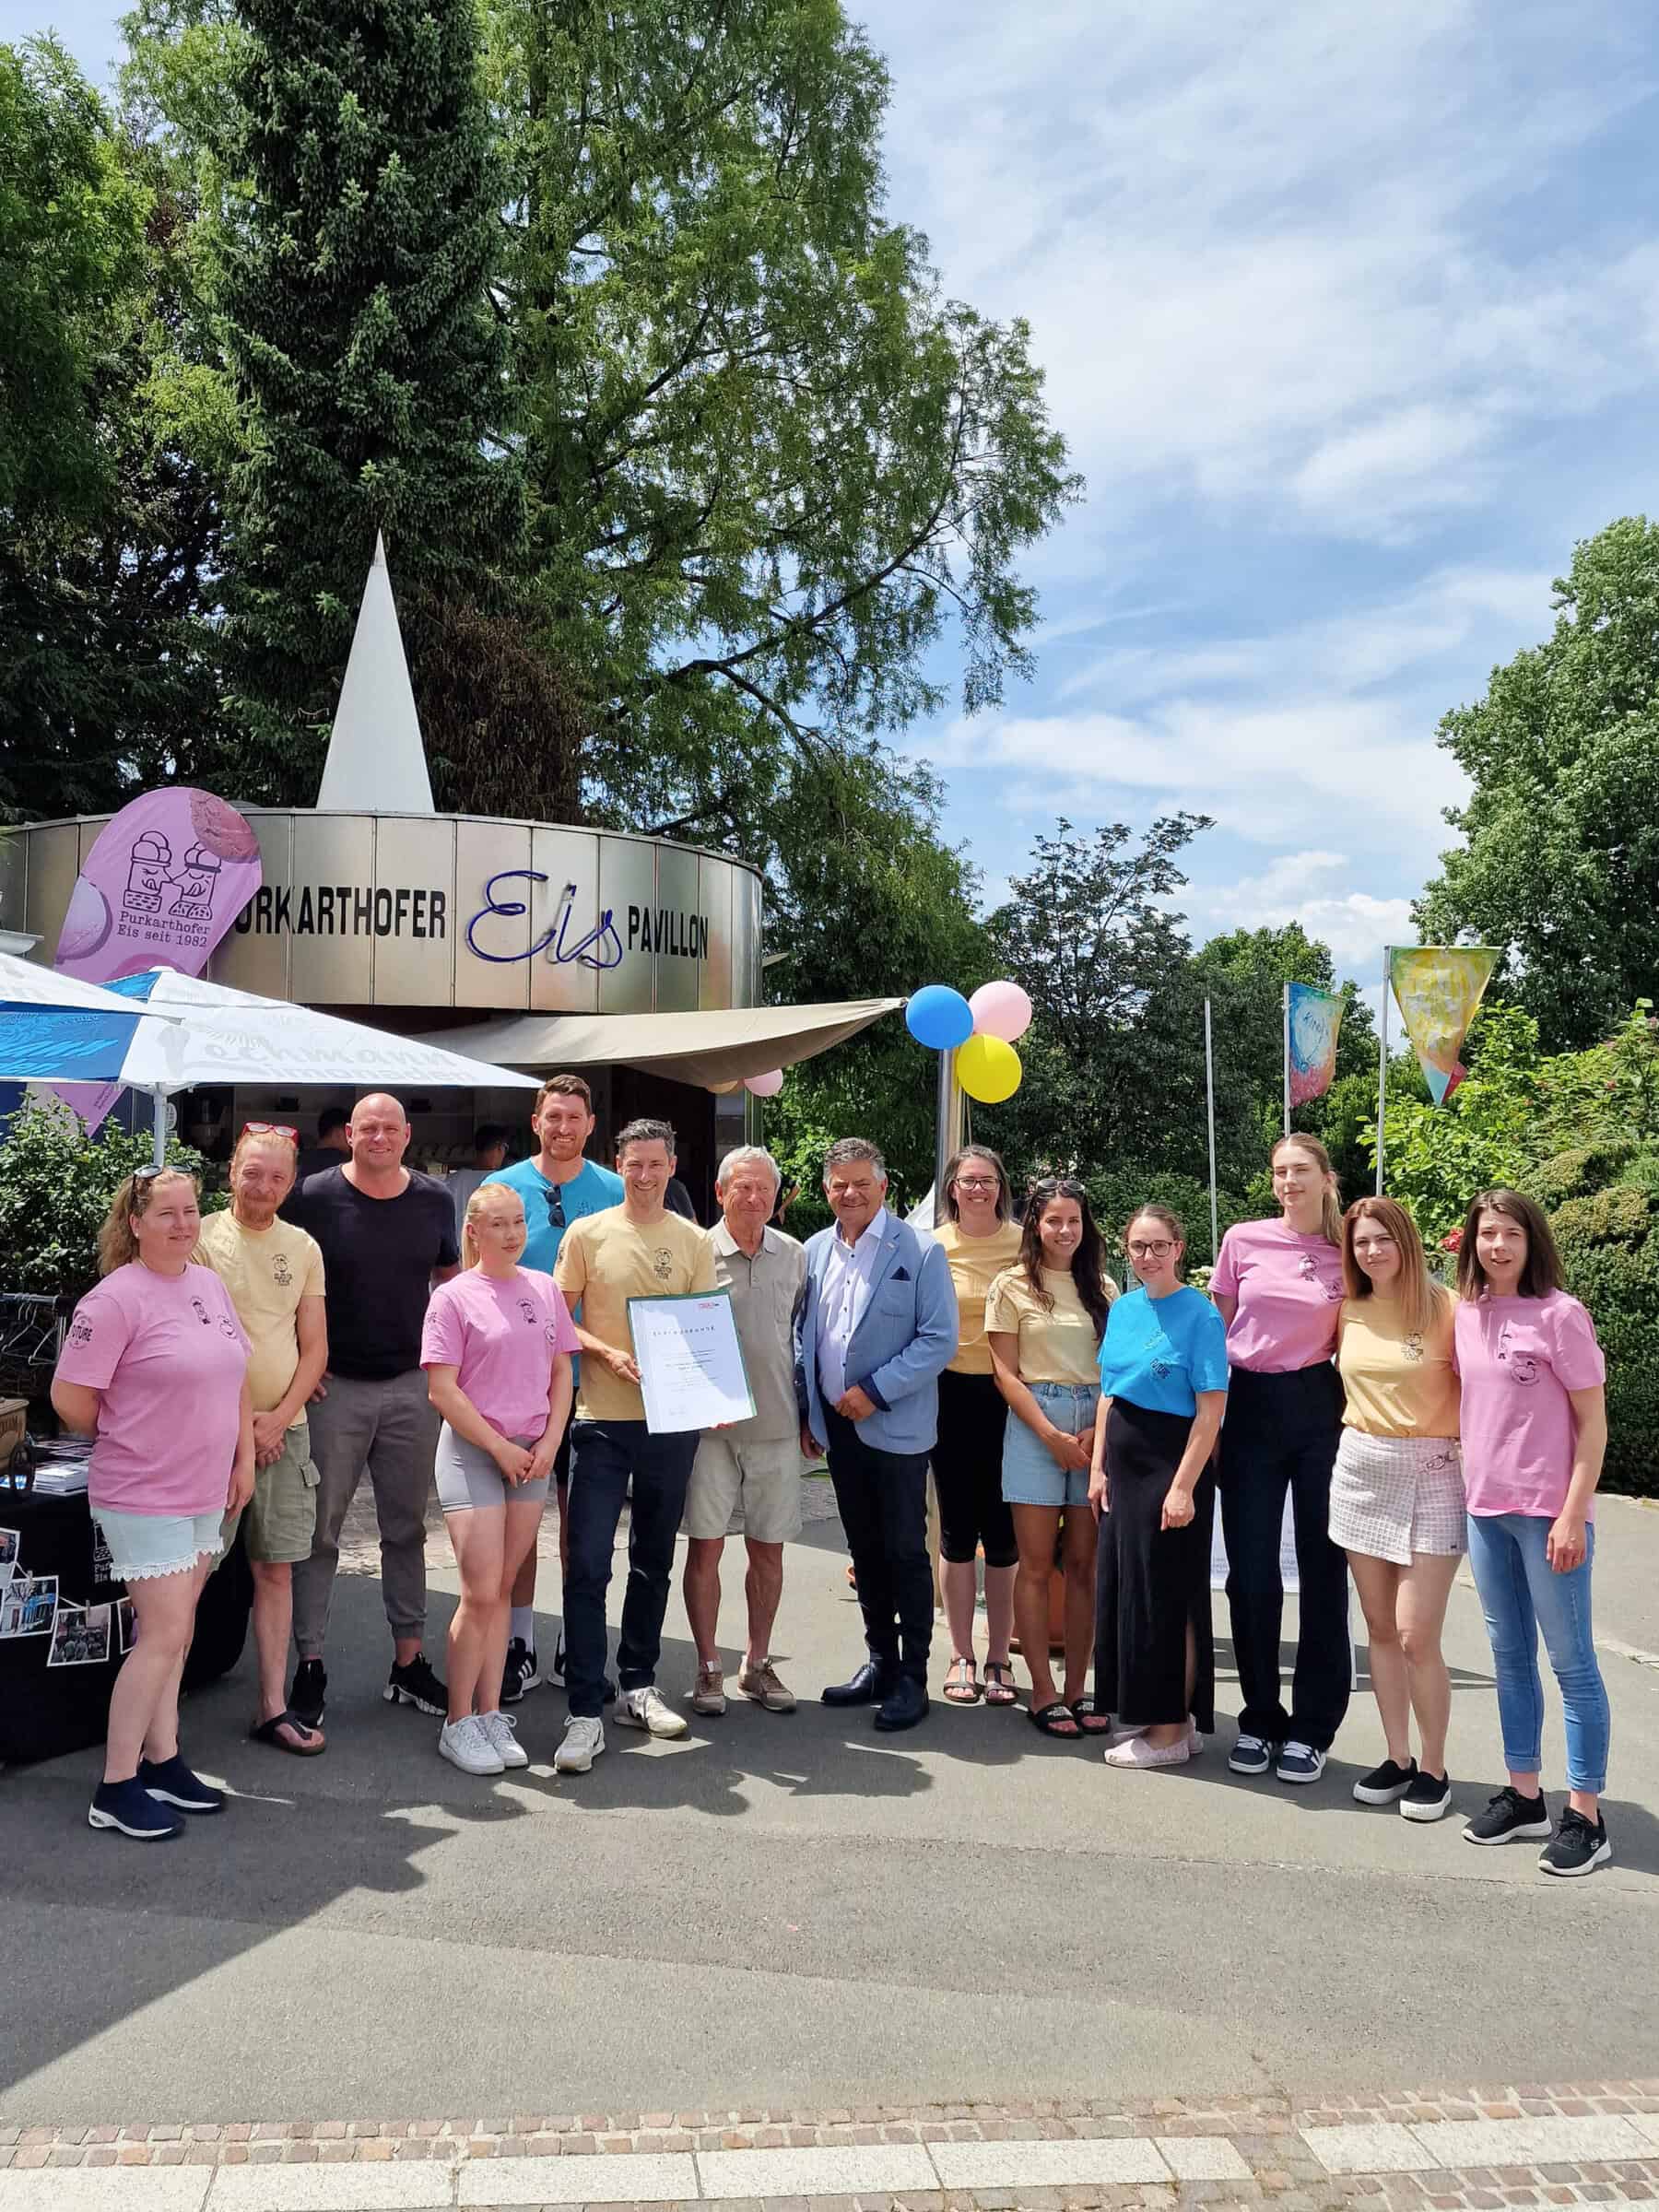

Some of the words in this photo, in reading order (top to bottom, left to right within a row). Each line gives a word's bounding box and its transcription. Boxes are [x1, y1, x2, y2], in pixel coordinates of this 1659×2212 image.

[119, 911, 211, 935] Purkarthofer
[234, 886, 446, 938] URKARTHOFER
[467, 870, 623, 968] Eis
[628, 905, 709, 959] PAVILLON
[117, 924, 139, 937] Eis
[145, 930, 171, 943] seit
[176, 935, 208, 947] 1982
